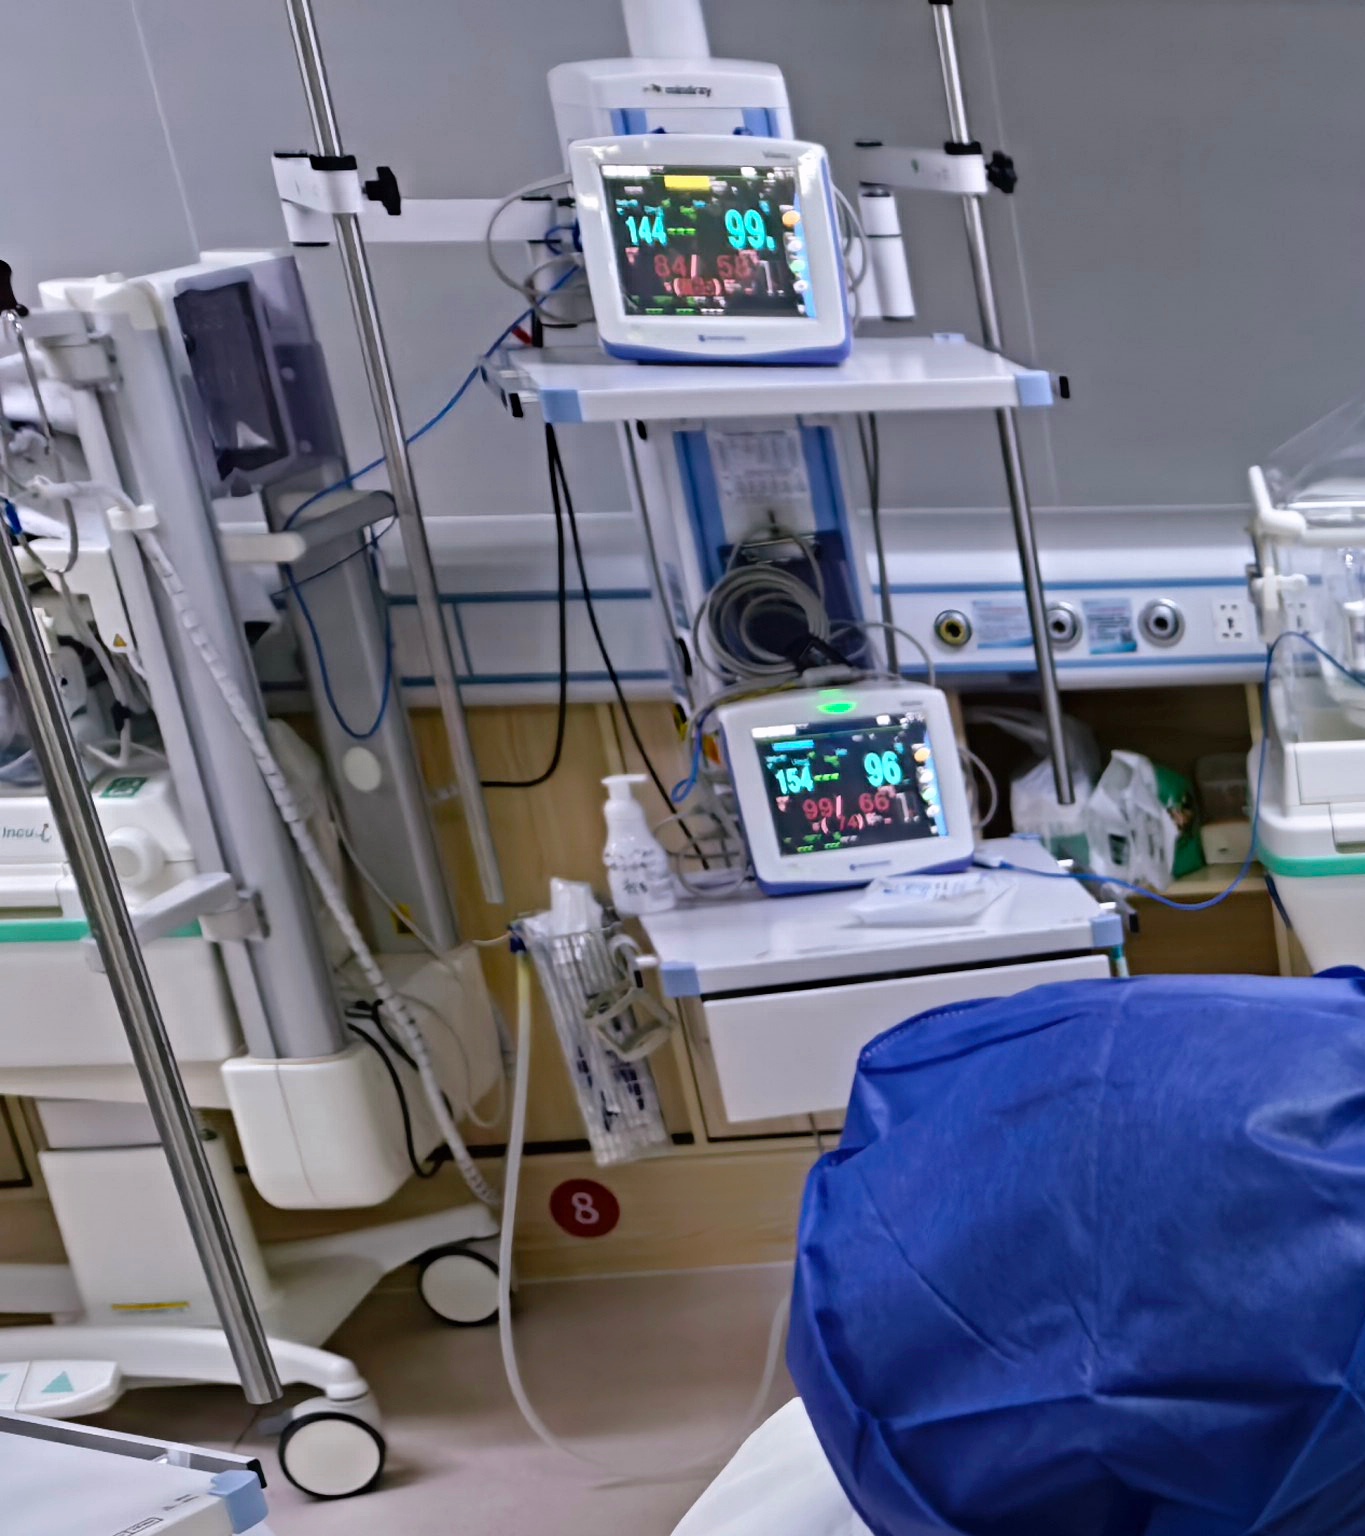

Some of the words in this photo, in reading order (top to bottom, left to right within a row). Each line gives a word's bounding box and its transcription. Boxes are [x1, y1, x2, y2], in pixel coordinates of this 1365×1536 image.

[625, 216, 668, 246] 144
[724, 209, 766, 250] 99
[775, 767, 814, 794] 154
[864, 751, 901, 787] 96
[571, 1192, 599, 1225] 8
